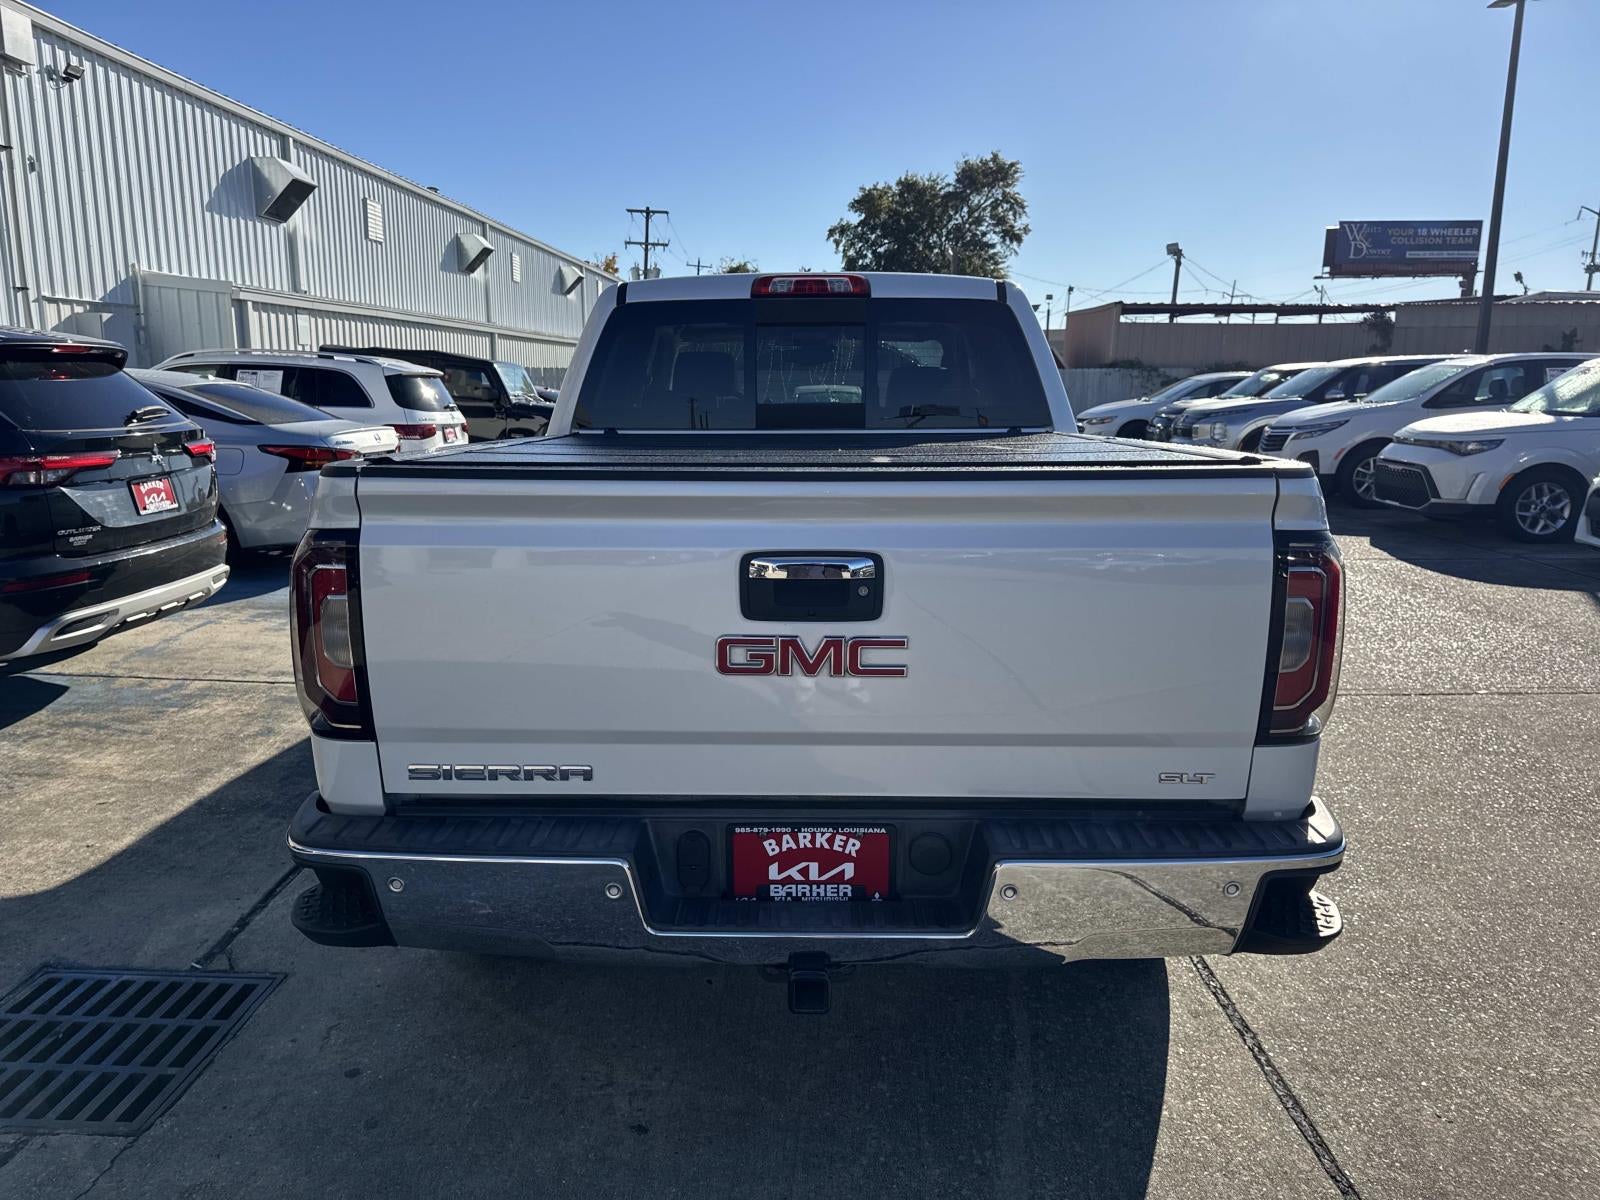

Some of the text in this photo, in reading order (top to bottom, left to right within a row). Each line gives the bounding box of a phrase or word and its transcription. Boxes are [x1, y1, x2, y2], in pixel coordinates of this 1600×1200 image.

[1387, 228, 1414, 236] YOUR
[1430, 227, 1479, 236] WHEELER
[1390, 237, 1473, 245] COLLISION TEAM
[715, 635, 909, 677] GMC
[407, 764, 593, 782] SIERRA
[1159, 772, 1216, 784] SLT
[763, 832, 861, 857] BARKER
[768, 861, 855, 881] KIA
